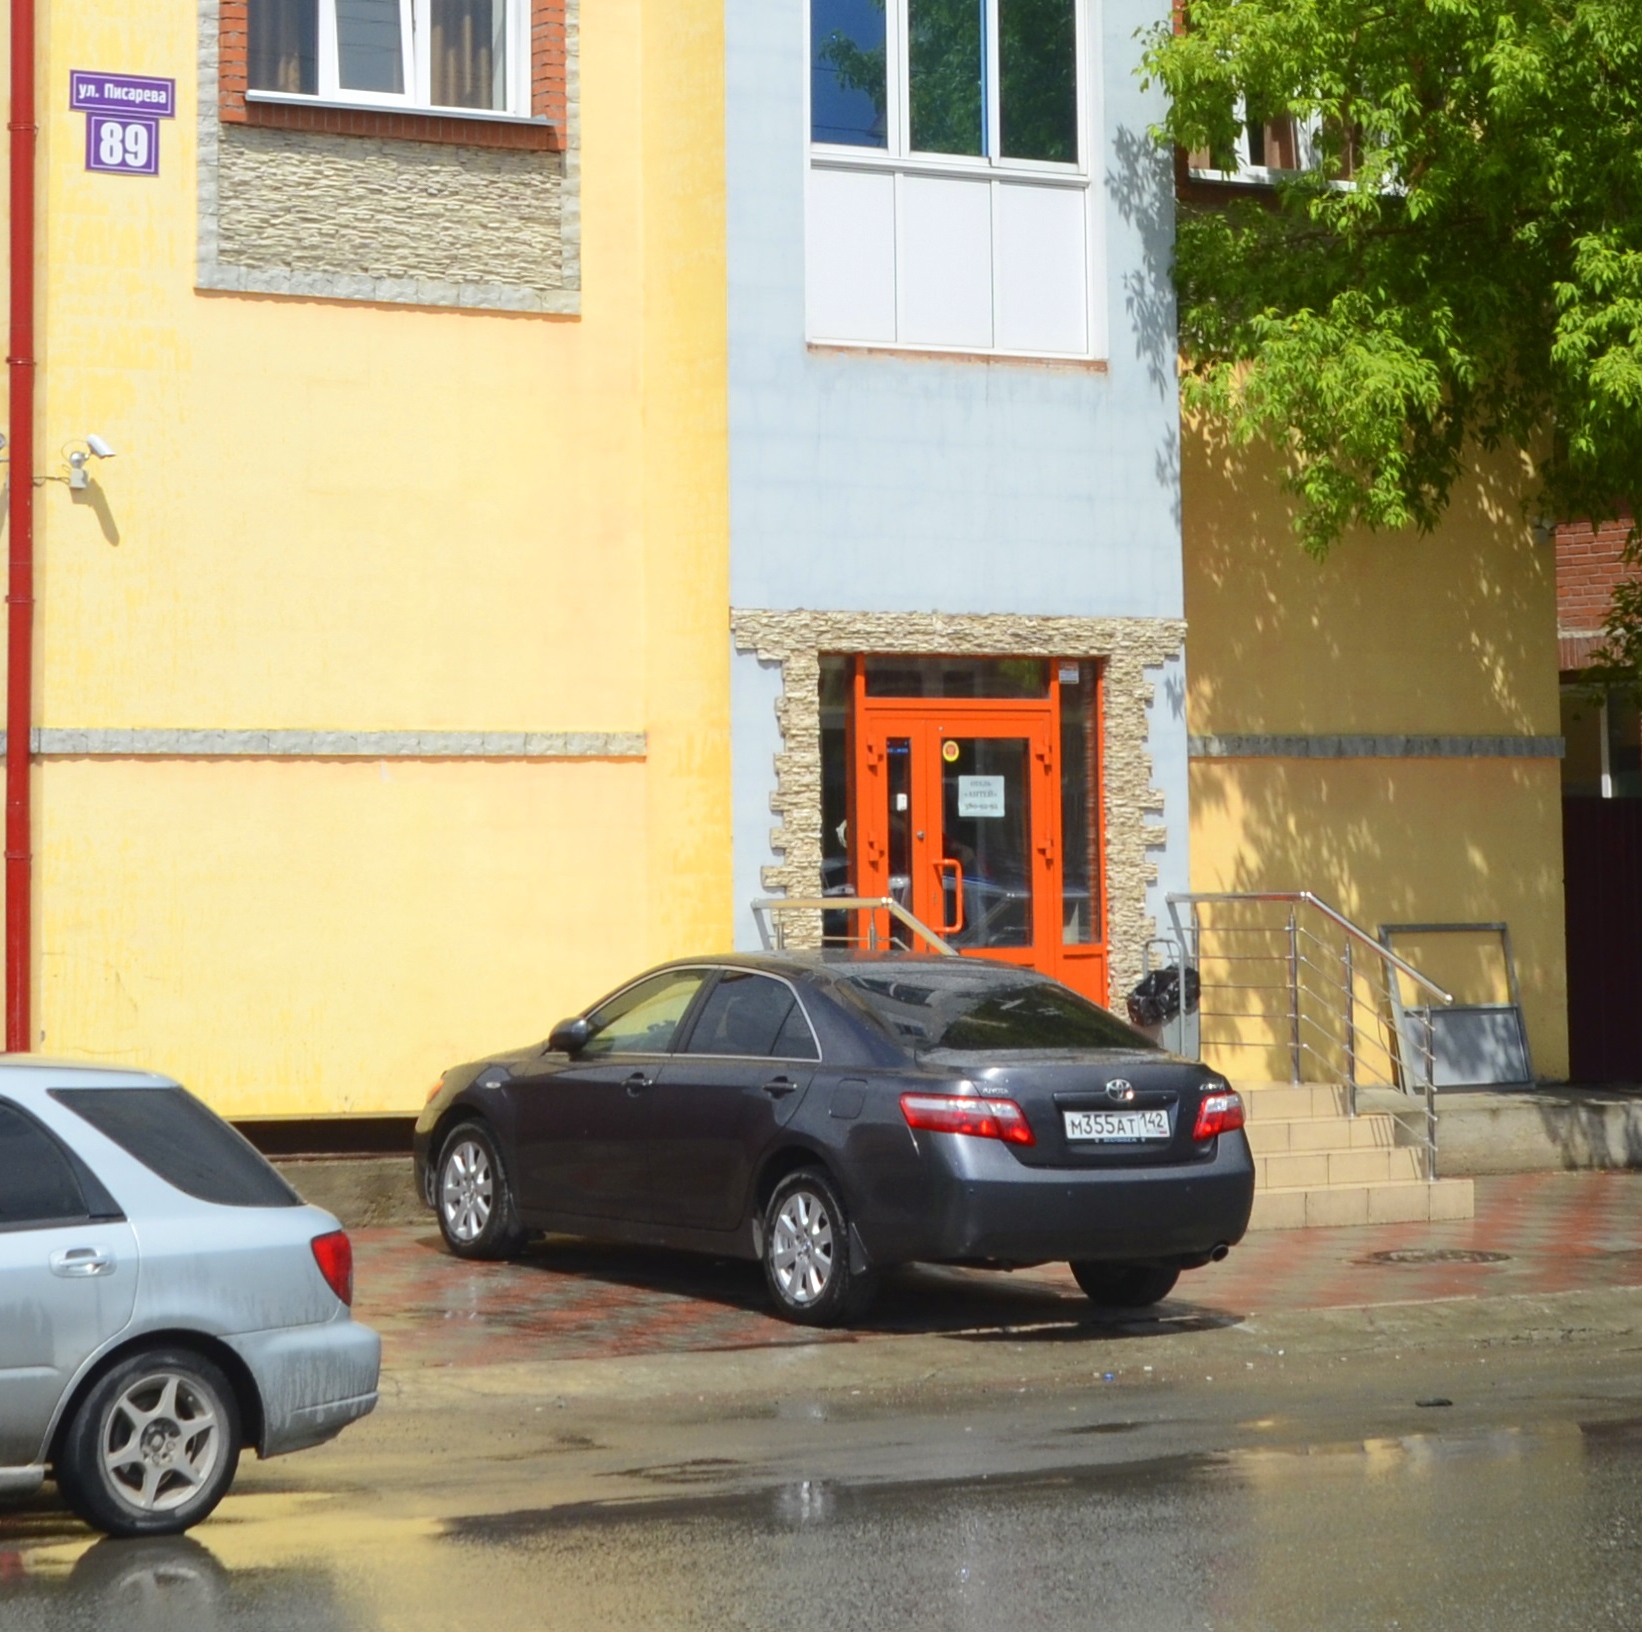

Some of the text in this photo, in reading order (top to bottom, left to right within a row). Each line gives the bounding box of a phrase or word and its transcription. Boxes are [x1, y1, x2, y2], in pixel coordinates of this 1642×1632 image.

[78, 83, 167, 105] ул. Писарева
[99, 121, 148, 167] 89
[1070, 1112, 1164, 1136] М355АТ 142
